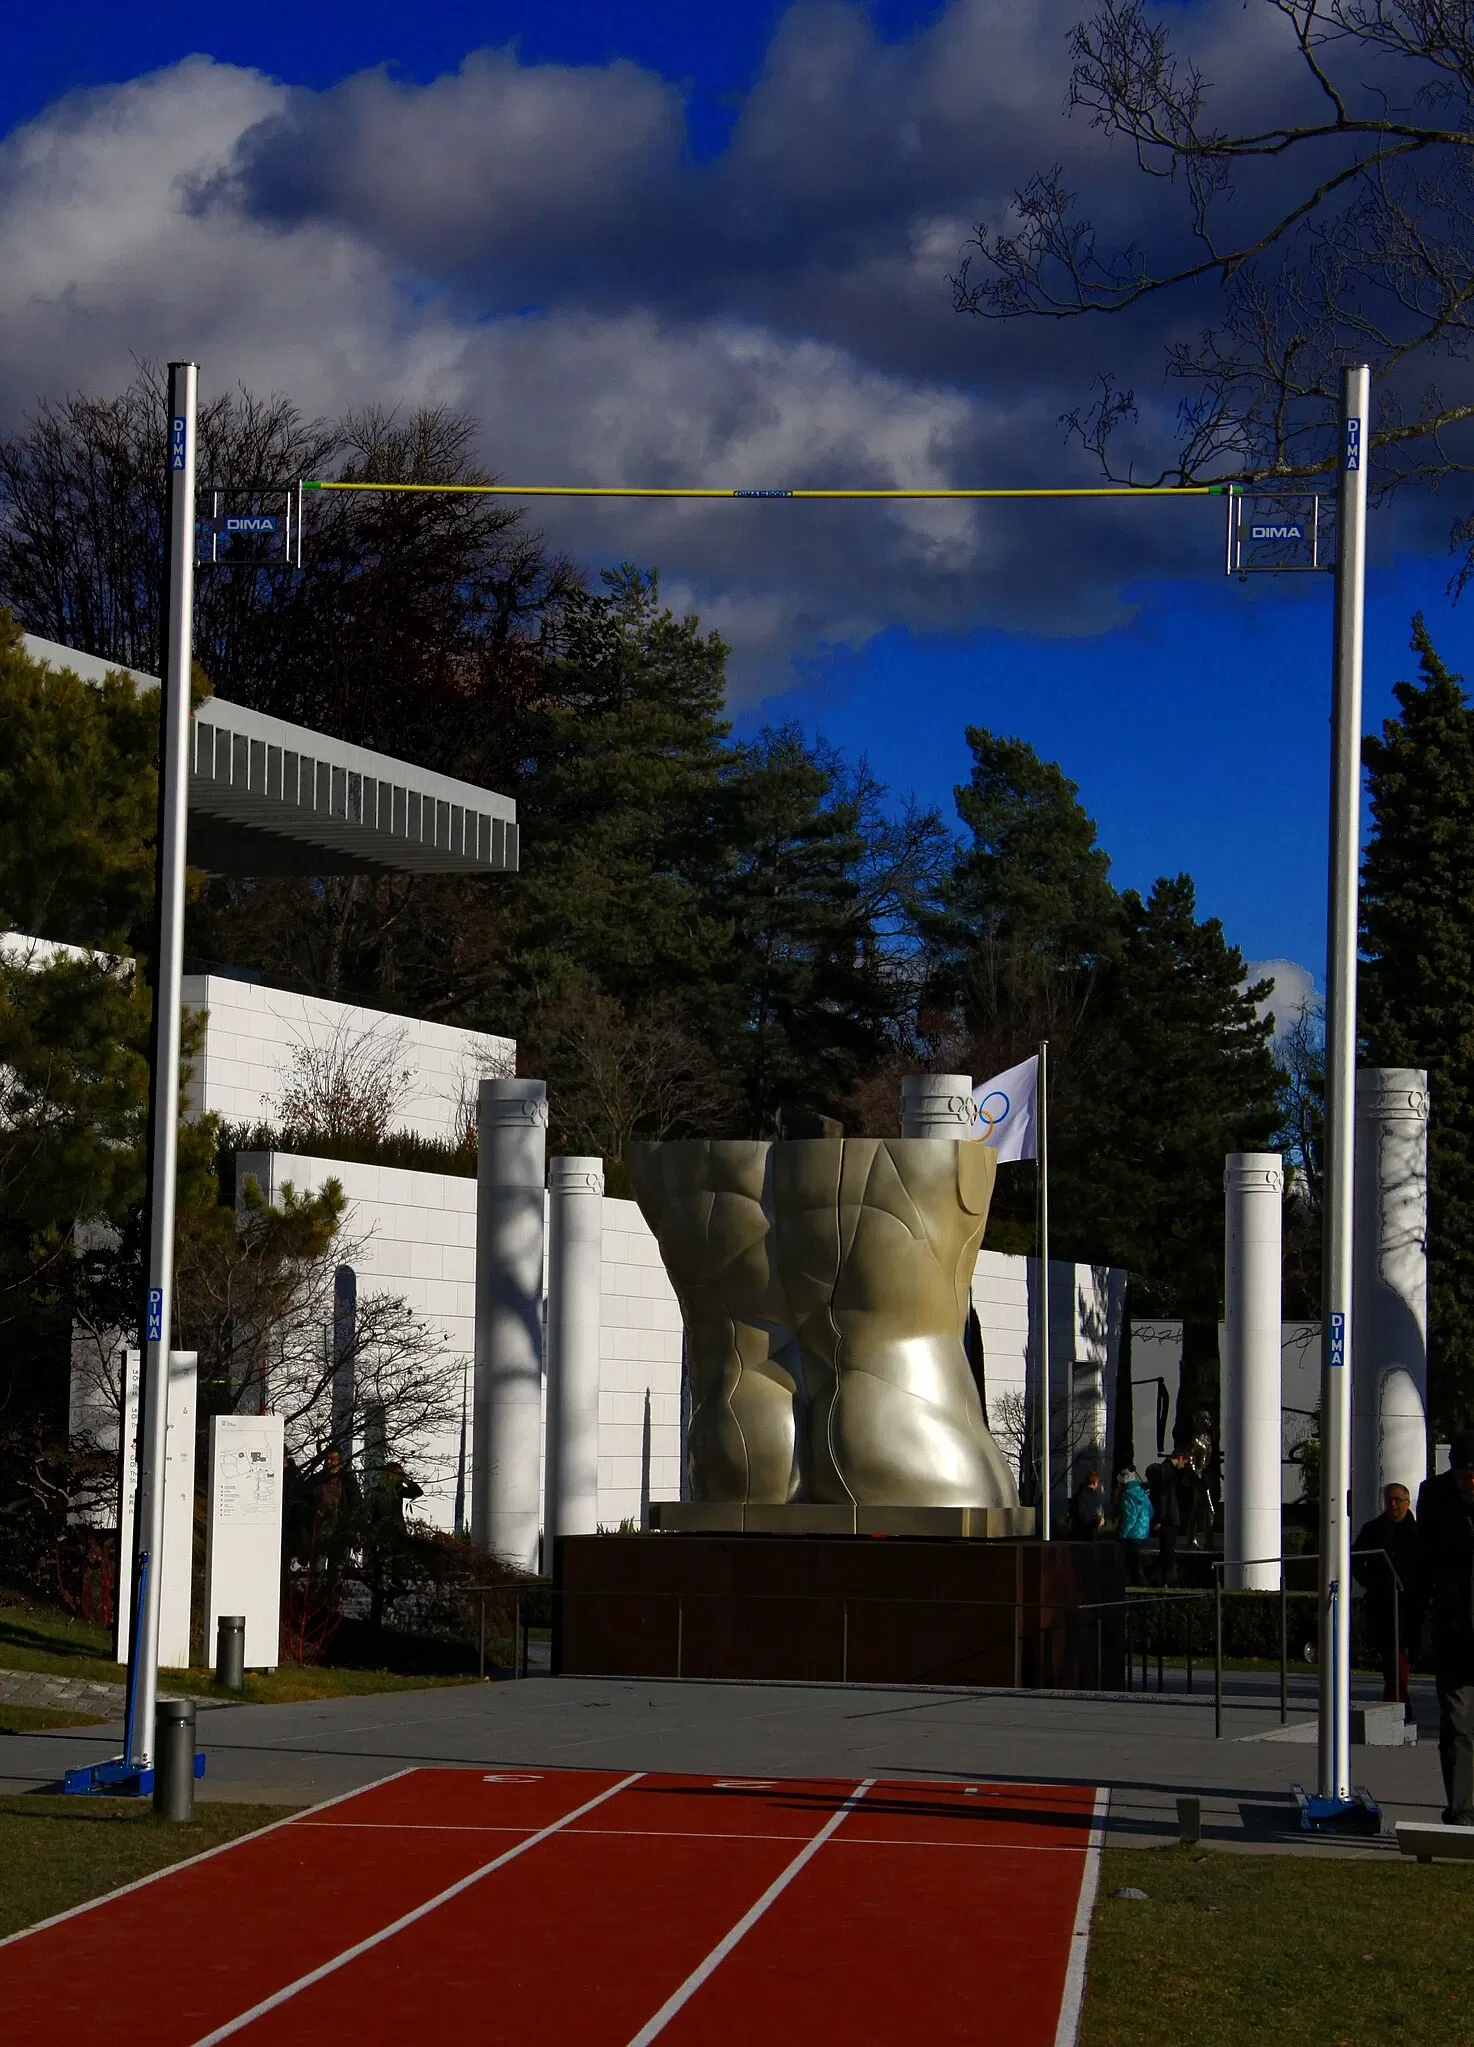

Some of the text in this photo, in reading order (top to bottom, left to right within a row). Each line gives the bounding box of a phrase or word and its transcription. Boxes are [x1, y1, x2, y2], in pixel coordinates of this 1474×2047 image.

[173, 420, 184, 468] DIMA
[1346, 420, 1358, 469] DIMA
[227, 519, 274, 531] DIMA
[1252, 526, 1302, 539] DIMA
[149, 1290, 161, 1339] DIMA
[1331, 1314, 1343, 1364] DIMA
